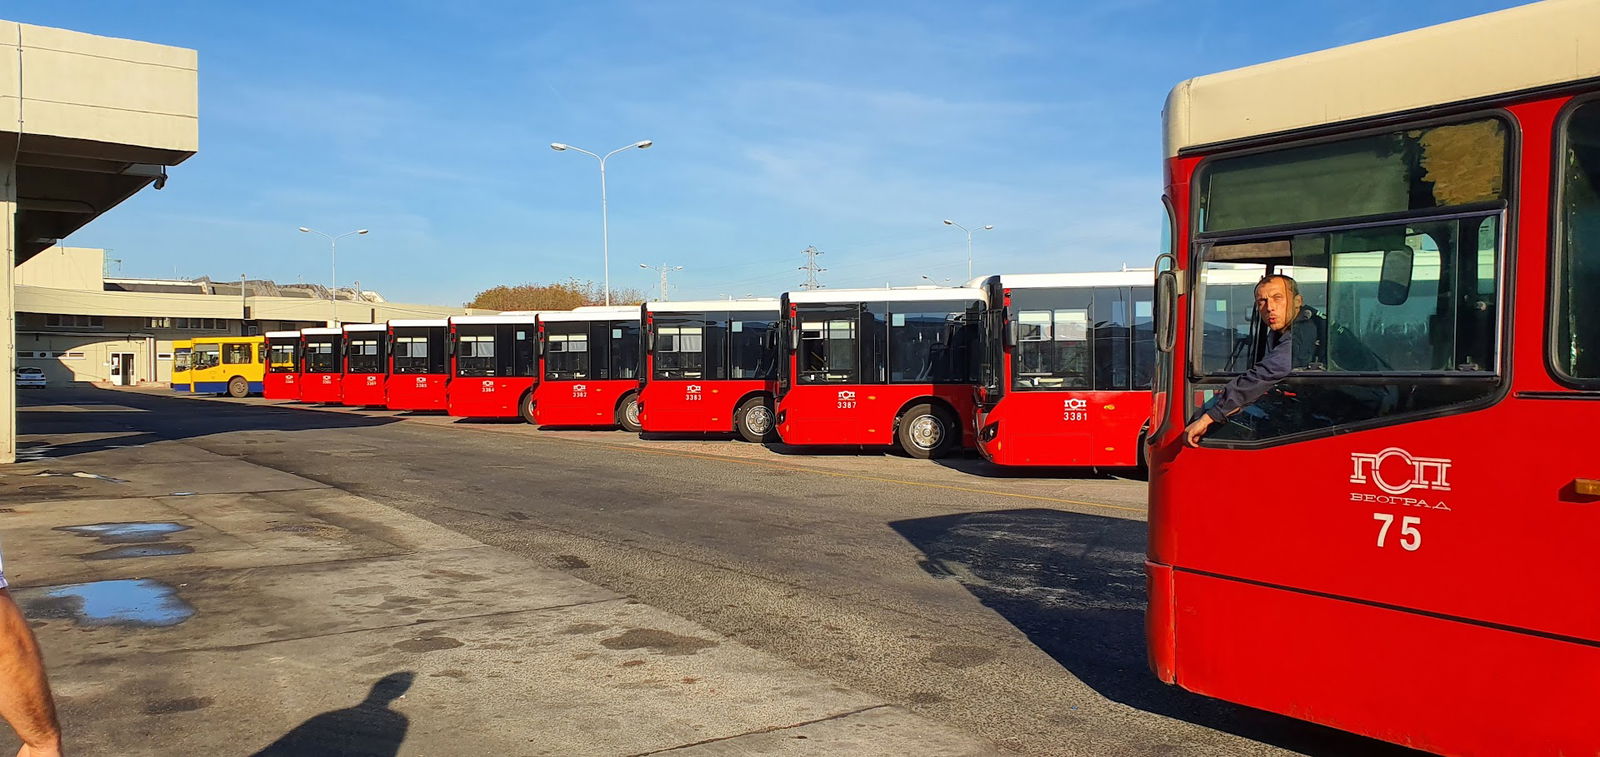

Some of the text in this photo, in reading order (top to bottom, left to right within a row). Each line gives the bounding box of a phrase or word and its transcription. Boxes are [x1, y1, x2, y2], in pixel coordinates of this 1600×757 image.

[837, 401, 857, 409] 3387
[1063, 412, 1088, 421] 3381
[1350, 447, 1452, 495] ГСП
[1373, 512, 1422, 552] 75
